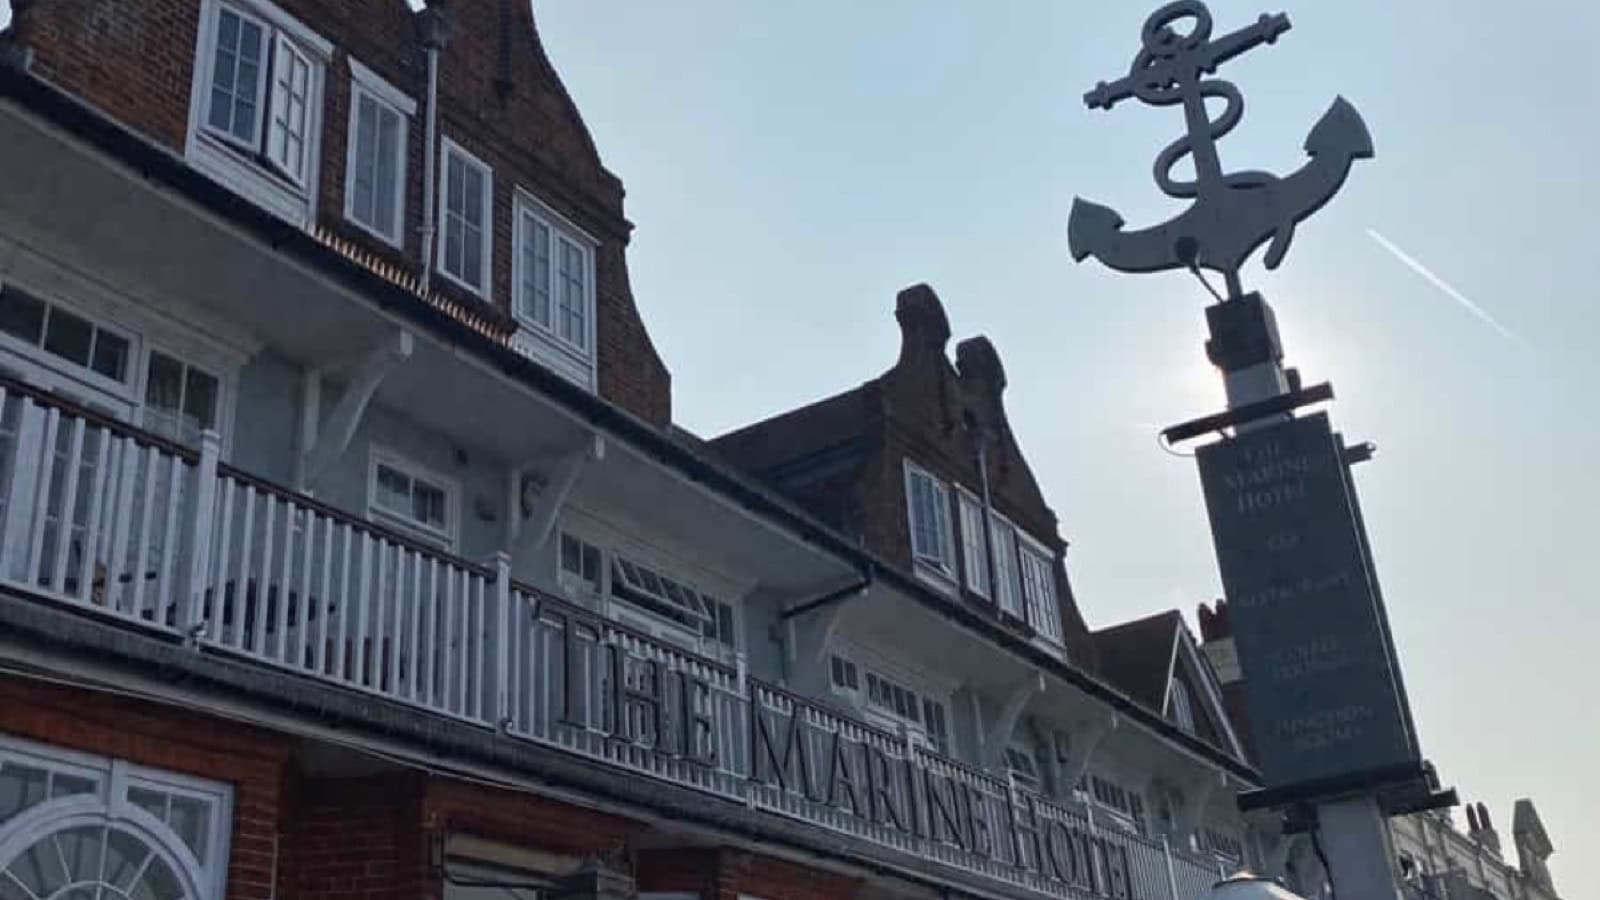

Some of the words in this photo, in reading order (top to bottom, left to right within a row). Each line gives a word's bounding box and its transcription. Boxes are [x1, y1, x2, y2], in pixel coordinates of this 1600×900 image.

[1223, 455, 1310, 490] MARINE
[1237, 480, 1309, 515] HOTEL
[532, 594, 717, 768] THE
[750, 680, 998, 860] MARINE
[1000, 780, 1133, 900] HOTEL
